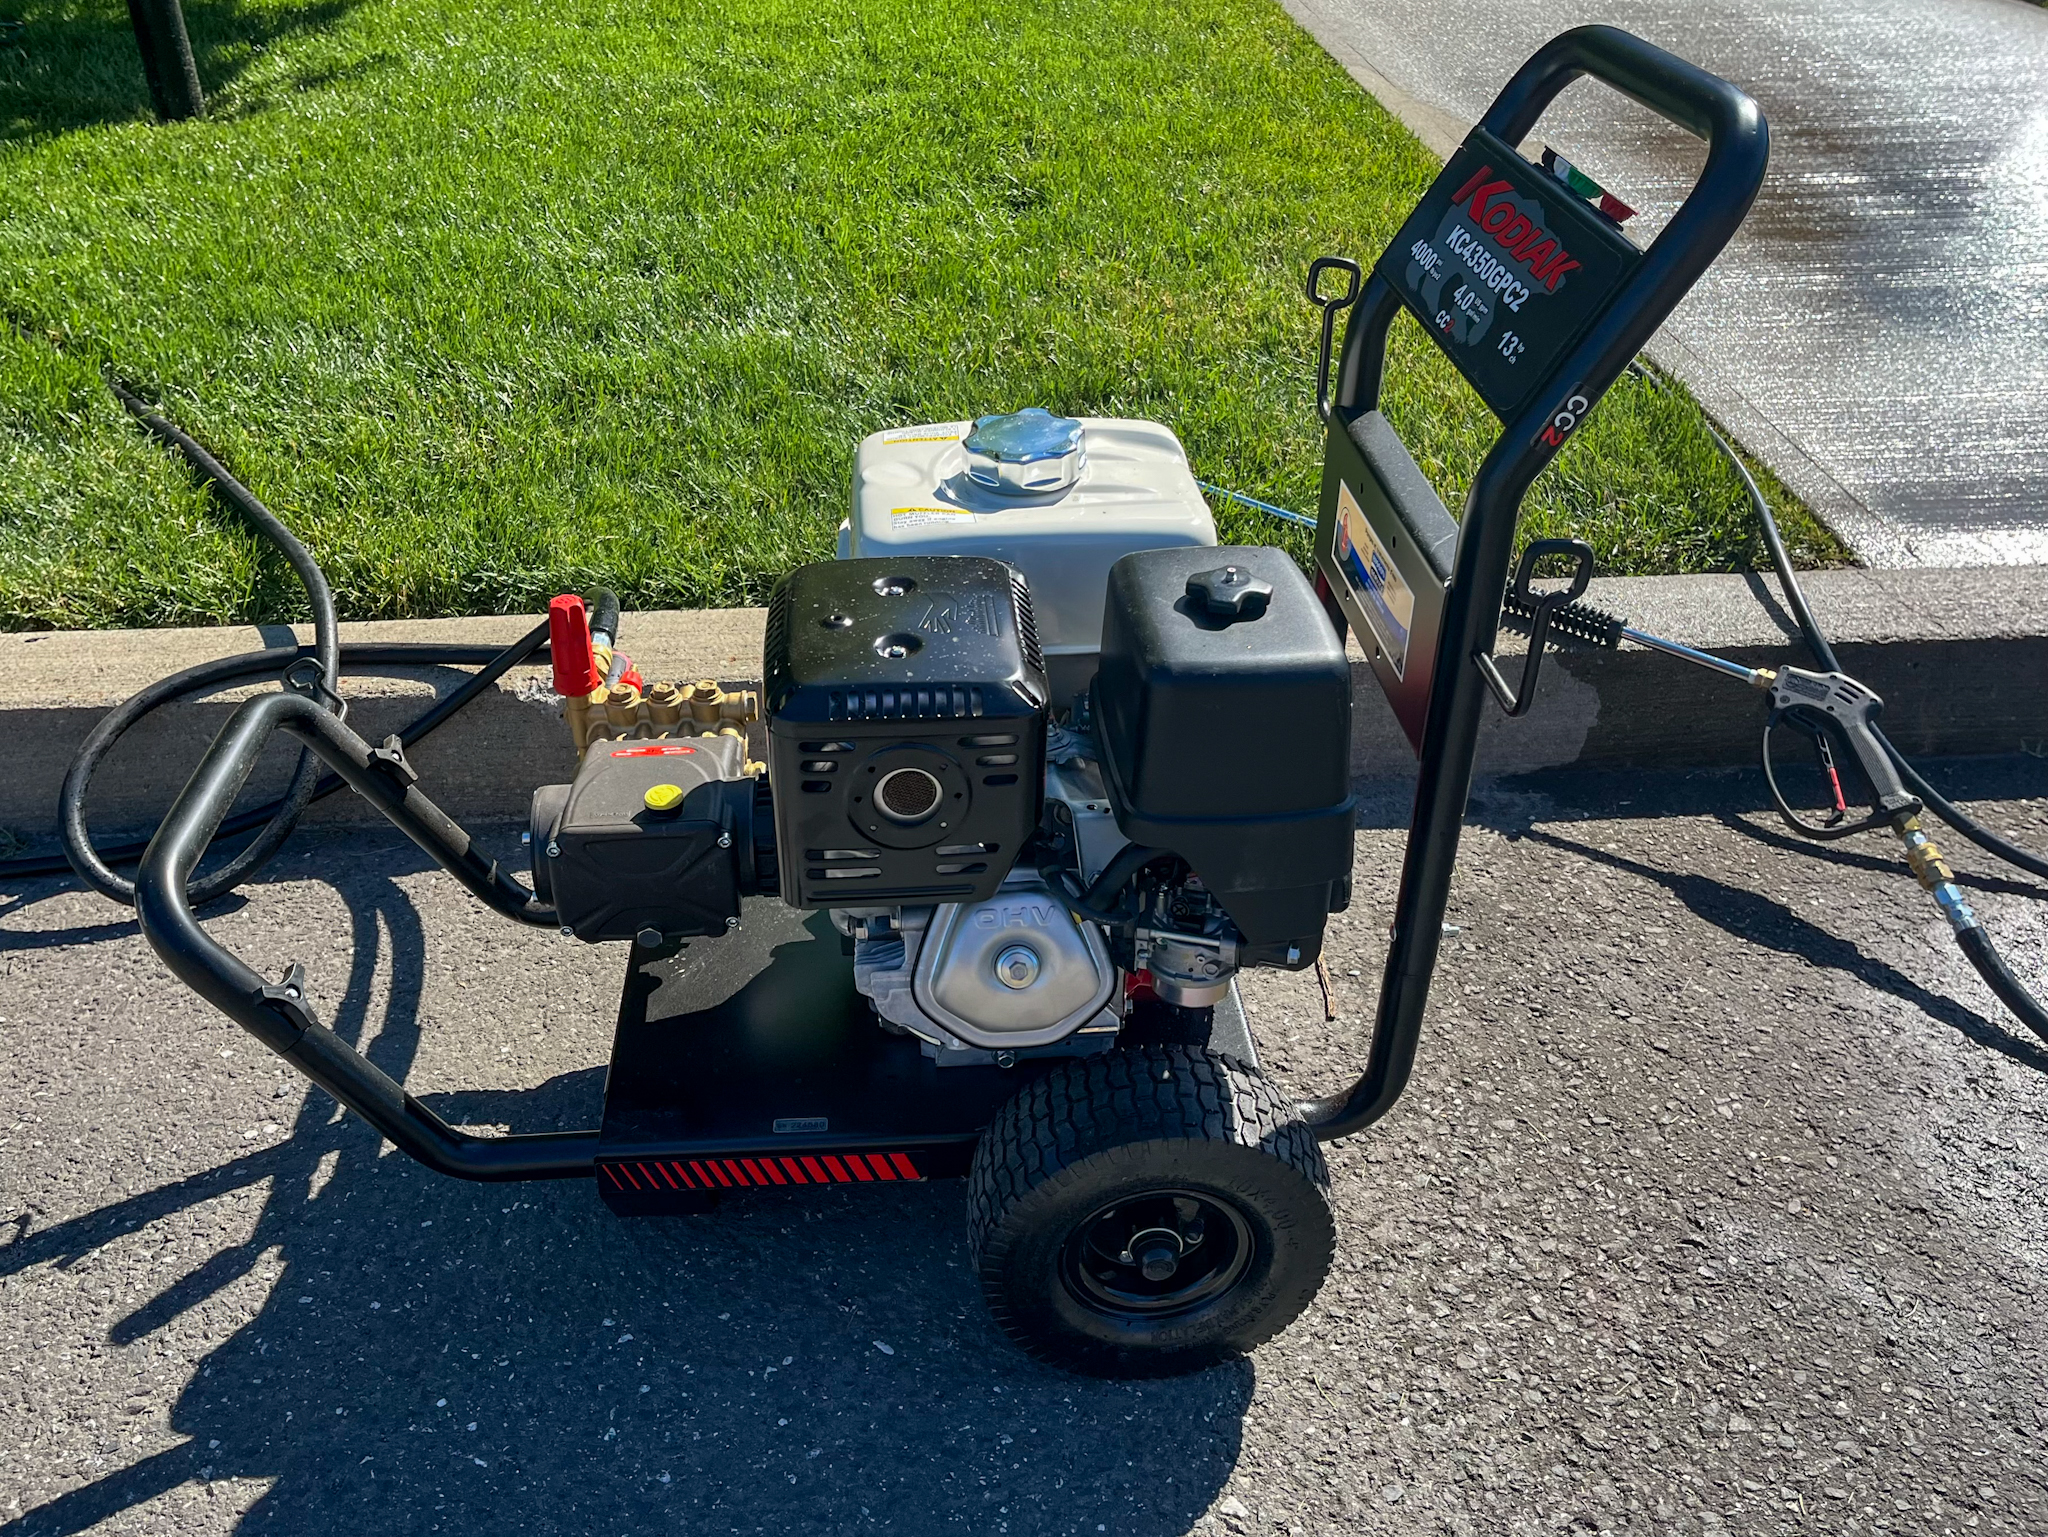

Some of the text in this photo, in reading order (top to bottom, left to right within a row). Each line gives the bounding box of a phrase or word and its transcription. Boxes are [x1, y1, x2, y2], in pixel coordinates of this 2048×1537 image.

[1451, 164, 1584, 292] KODIAK
[1411, 239, 1438, 271] 4000
[1445, 224, 1531, 313] KC4350GPC2
[1453, 284, 1476, 311] 4.0
[1435, 310, 1455, 334] CC2
[1496, 331, 1526, 358] 13 hp
[1541, 394, 1589, 447] CC2
[974, 905, 1055, 929] OHV
